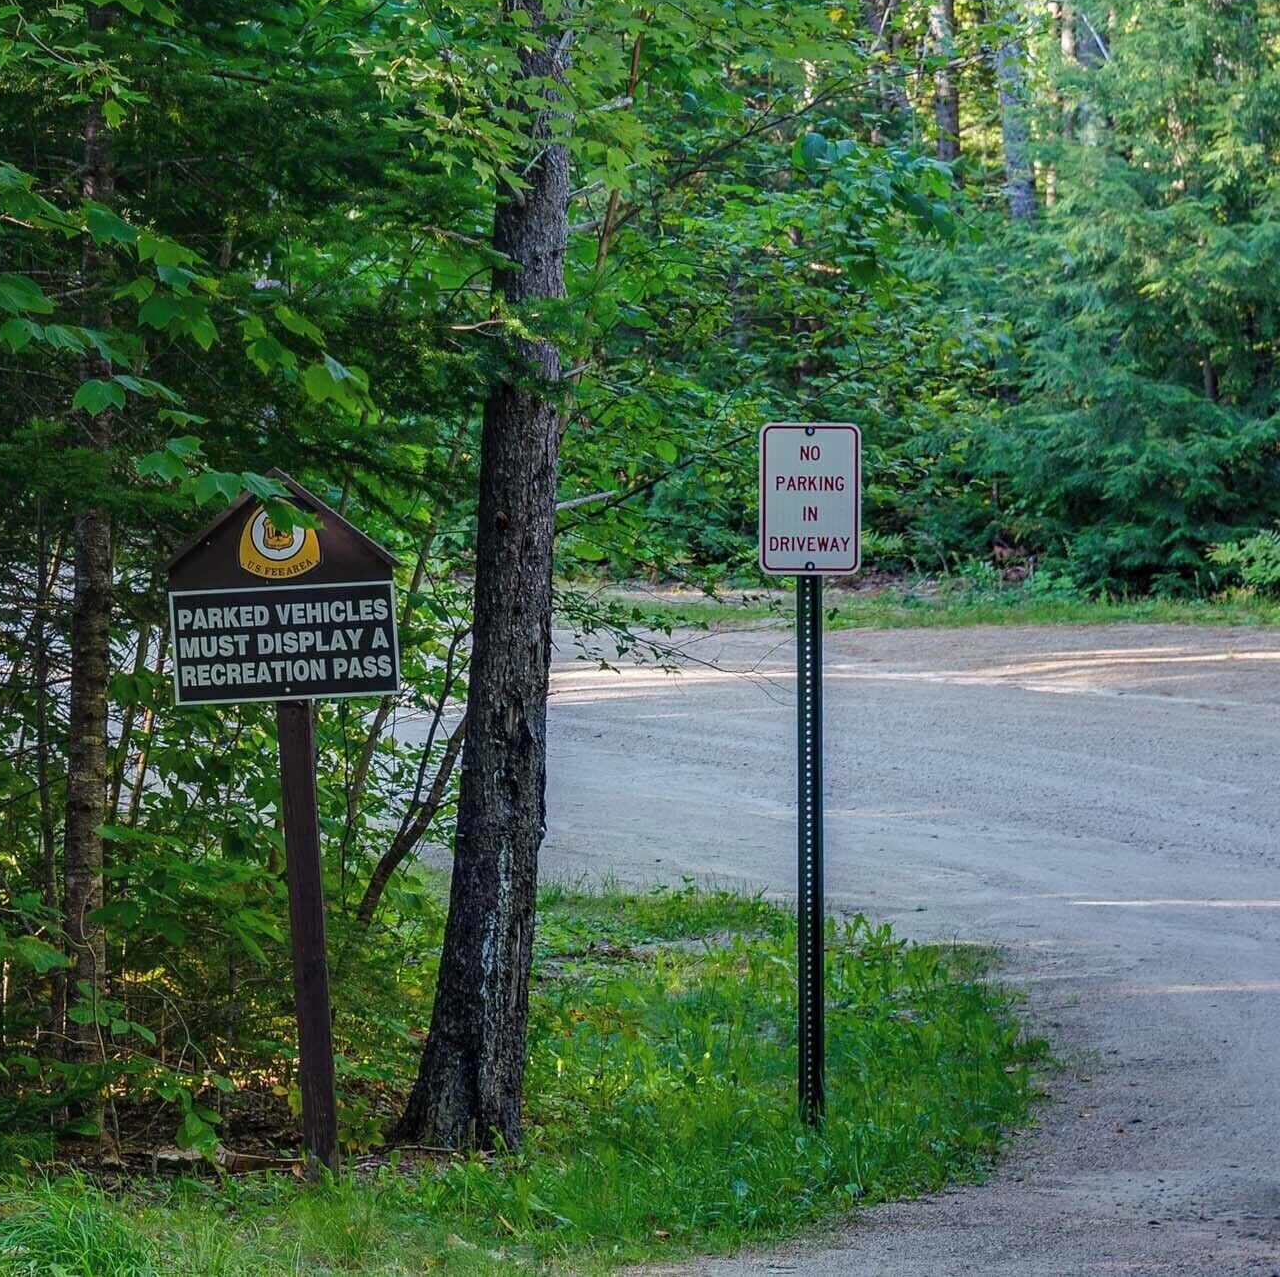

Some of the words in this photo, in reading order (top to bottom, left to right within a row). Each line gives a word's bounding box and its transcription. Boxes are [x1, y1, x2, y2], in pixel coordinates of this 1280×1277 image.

[799, 445, 821, 461] NO
[775, 476, 845, 492] PARKING
[802, 506, 818, 522] IN
[769, 536, 851, 553] DRIVEWAY
[265, 566, 285, 576] FEE
[286, 558, 313, 573] AREA
[178, 605, 270, 630] PARKED
[275, 598, 388, 626] VEHICLES
[180, 634, 250, 659] MUST
[257, 628, 364, 655] DISPLAY
[371, 627, 389, 649] A
[181, 658, 328, 687] RECREATION
[333, 654, 392, 680] PASS
